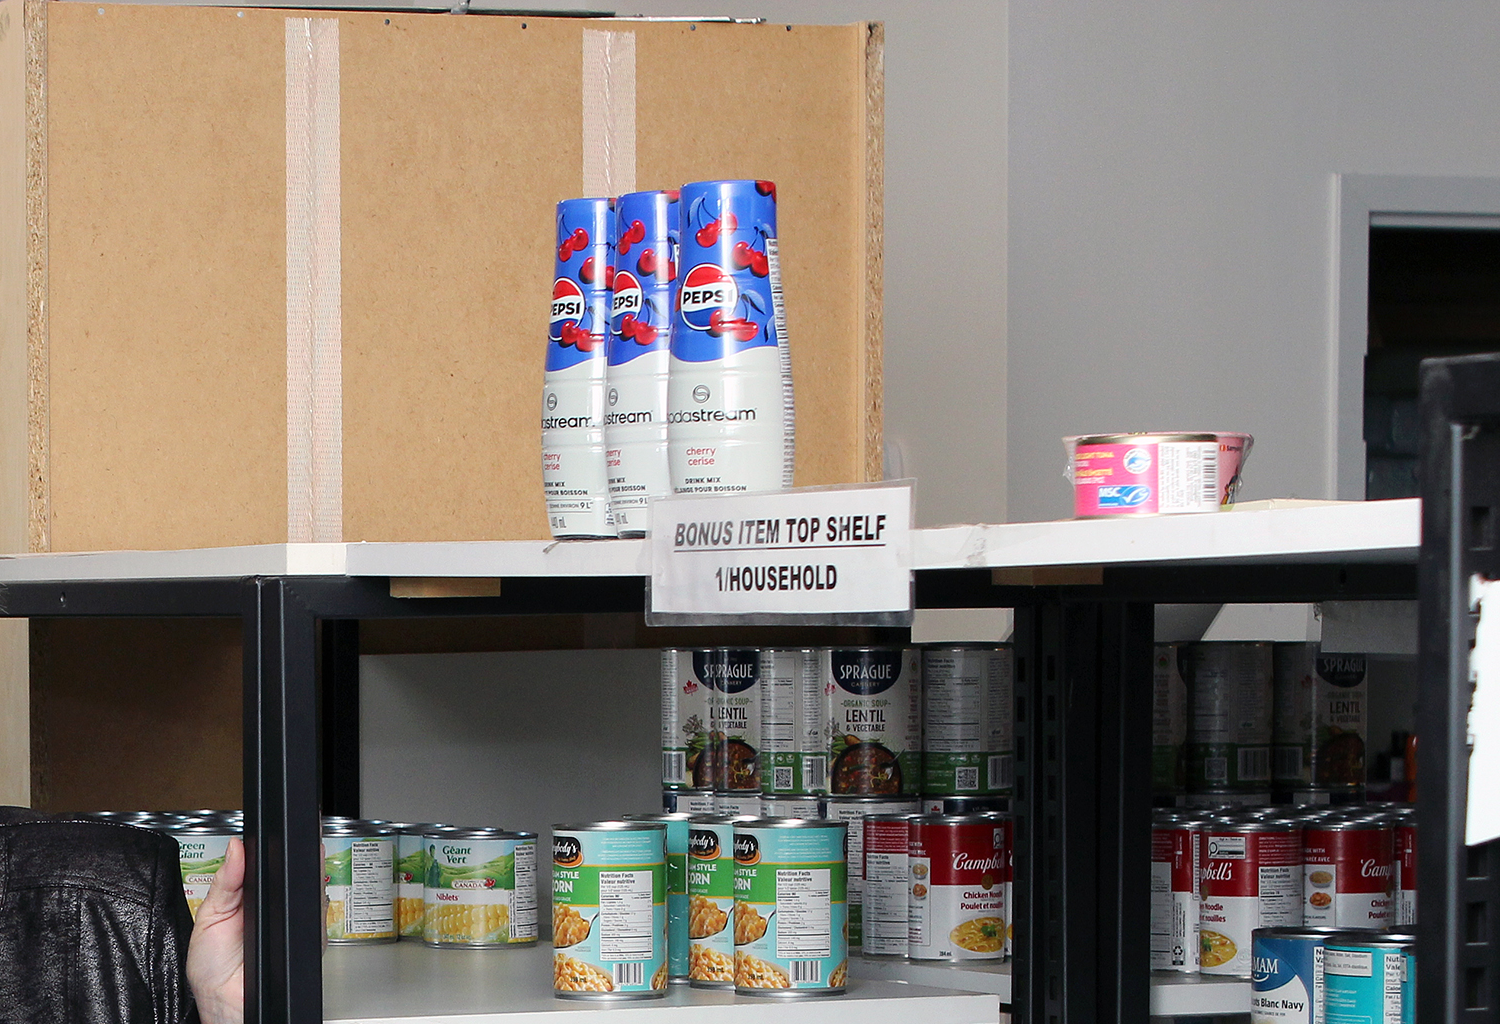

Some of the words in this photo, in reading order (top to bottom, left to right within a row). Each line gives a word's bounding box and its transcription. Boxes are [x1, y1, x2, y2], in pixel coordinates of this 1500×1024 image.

[613, 295, 639, 310] EPSI
[551, 303, 580, 315] EPSI
[667, 409, 757, 423] odastream
[686, 447, 716, 456] cherry
[688, 457, 715, 466] cerise
[1100, 487, 1122, 498] MSC
[675, 521, 733, 547] BONUS
[738, 519, 780, 545] ITEM
[786, 517, 820, 542] TOP
[826, 514, 887, 541] SHELF
[715, 565, 838, 592] 1/HOUSEHOLD
[840, 664, 892, 680] SPRAGUE
[846, 709, 886, 723] LENTIL
[442, 845, 471, 855] Géant
[446, 855, 468, 864] Vert
[560, 871, 579, 879] STYLE
[1204, 903, 1223, 911] Noodle
[1260, 999, 1279, 1008] Blanc
[1281, 1000, 1304, 1011] Navy
